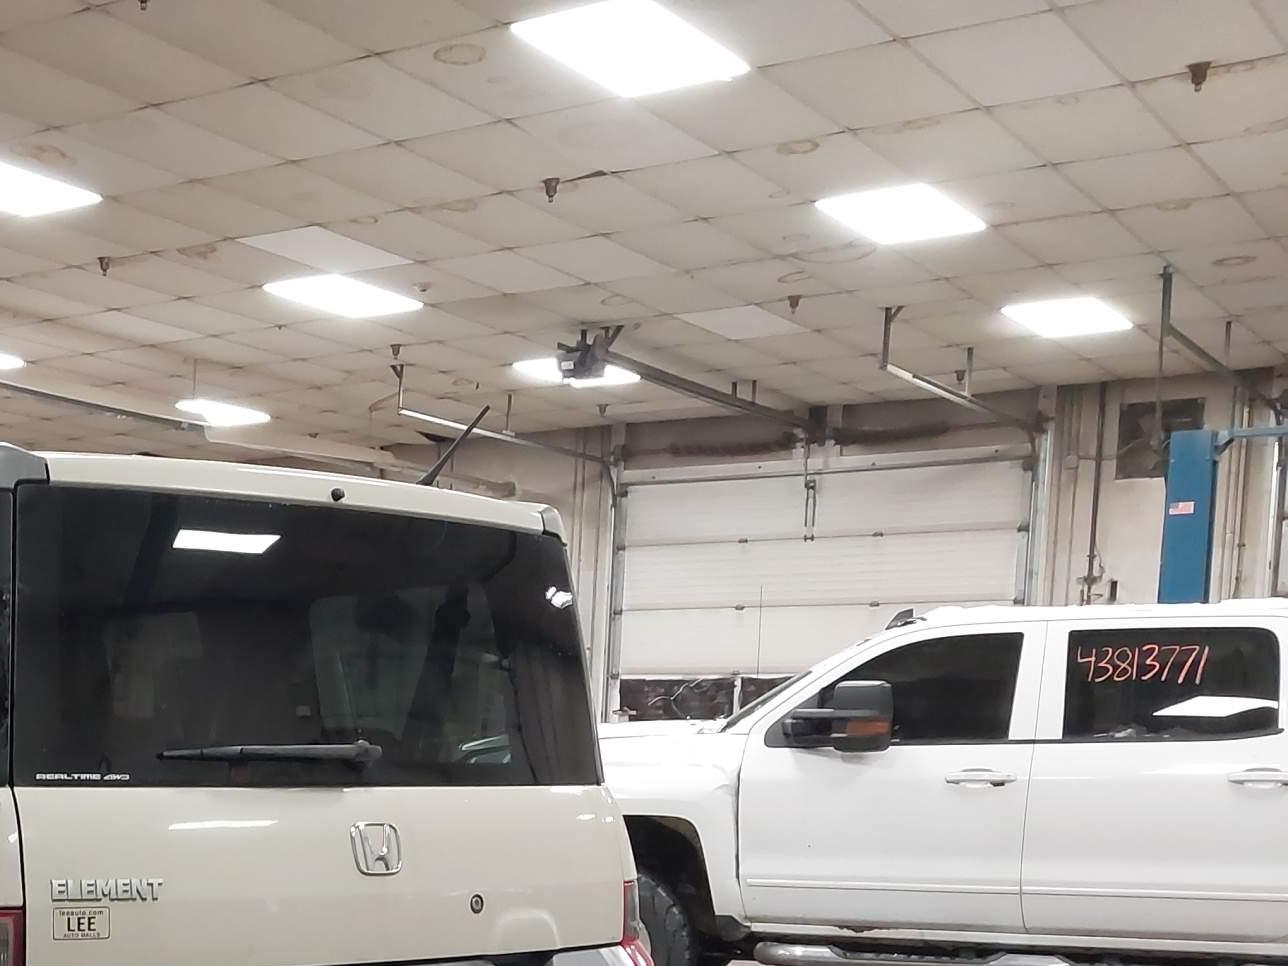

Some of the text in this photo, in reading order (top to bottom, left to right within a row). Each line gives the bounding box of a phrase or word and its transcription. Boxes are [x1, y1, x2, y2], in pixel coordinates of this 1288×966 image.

[1077, 643, 1209, 685] 43813771
[50, 879, 163, 902] ELEMENT
[67, 916, 97, 932] LEE
